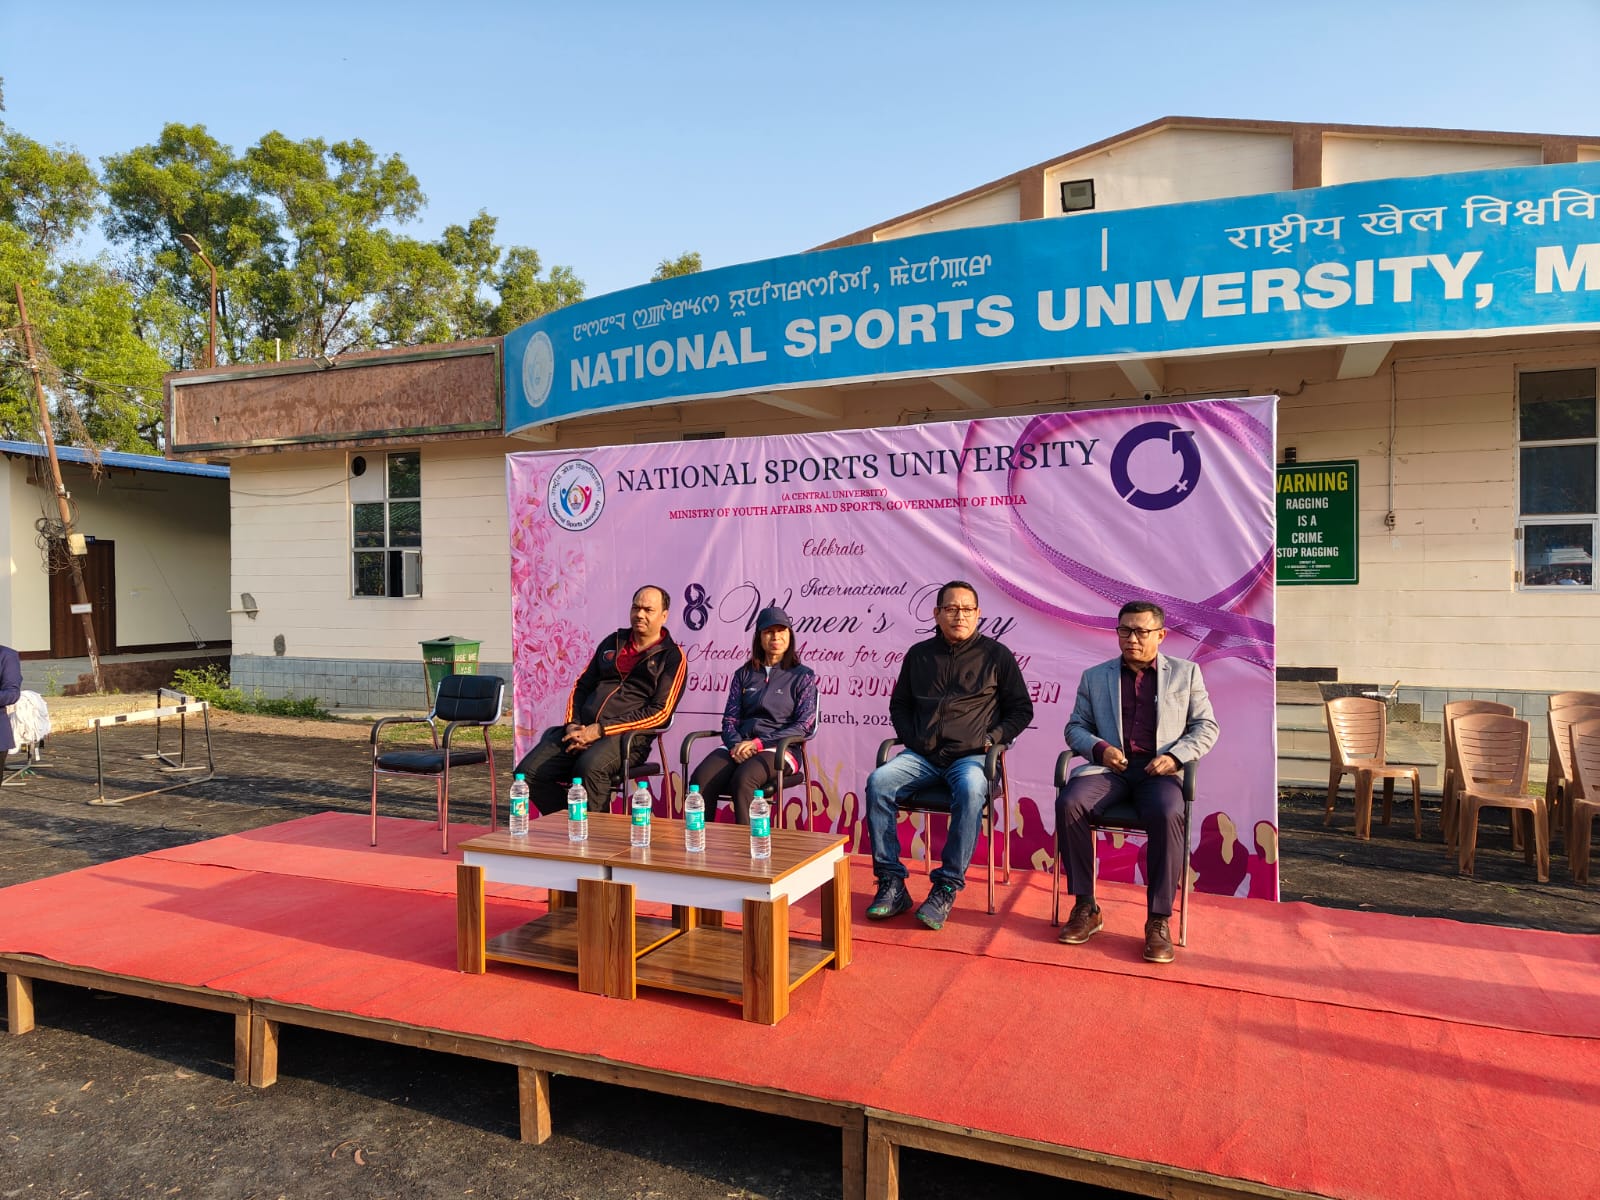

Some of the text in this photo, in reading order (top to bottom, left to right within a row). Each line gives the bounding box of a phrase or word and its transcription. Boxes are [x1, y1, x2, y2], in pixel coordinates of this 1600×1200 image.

[1224, 213, 1345, 255] राष्ट्रीय
[1357, 204, 1449, 236] खेल
[570, 326, 767, 392] NATIONAL
[784, 294, 1014, 359] SPORTS
[1037, 250, 1494, 331] UNIVERSITY,
[617, 462, 757, 493] NATIONAL
[764, 453, 880, 485] SPORTS
[888, 438, 1100, 478] UNIVERSITY
[781, 487, 888, 502] (A CENTRAL UNIVERSITY)
[1286, 497, 1329, 510] RAGGING
[669, 494, 1028, 520] MINISTRY OF YOUTH AFFAIRS AND SPORTS, GOVERNMENT OF INDIA
[1297, 514, 1318, 527] IS A
[802, 537, 866, 557] Celebrates
[1291, 531, 1324, 544] CRIME
[1276, 546, 1339, 558] STOP RAGGING
[801, 577, 908, 598] International
[848, 645, 882, 668] for
[848, 676, 898, 698] RUN
